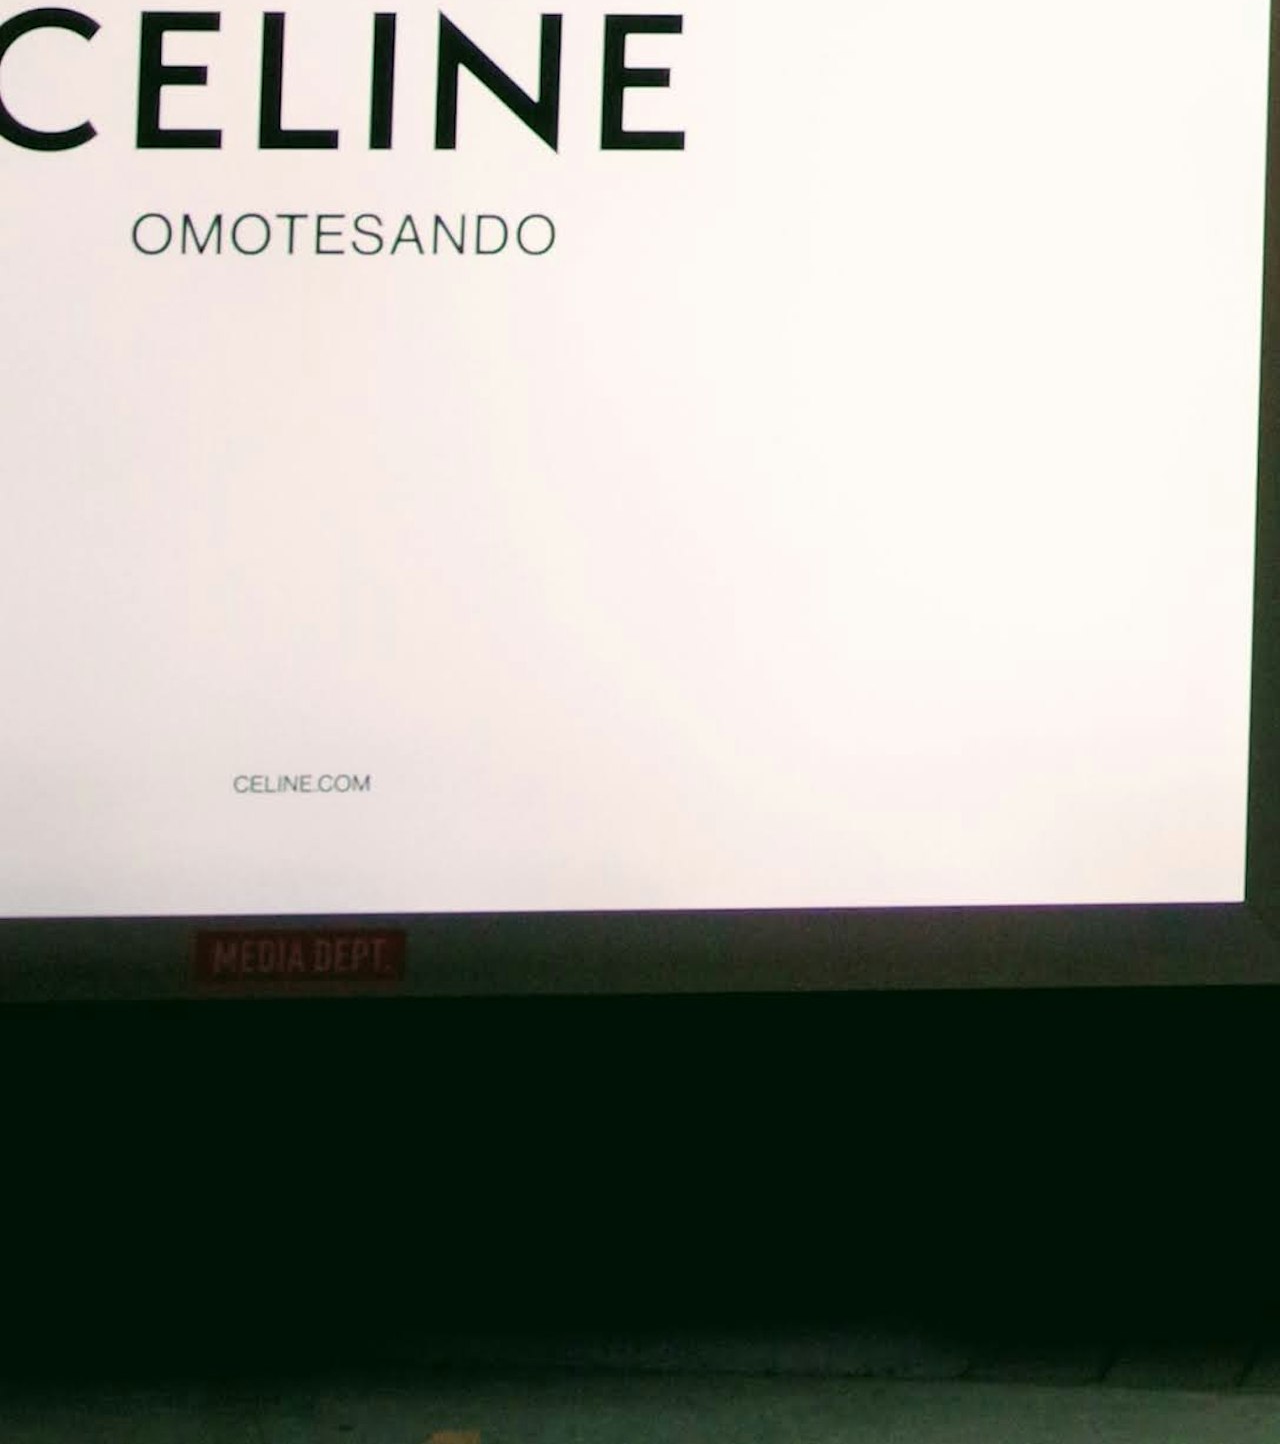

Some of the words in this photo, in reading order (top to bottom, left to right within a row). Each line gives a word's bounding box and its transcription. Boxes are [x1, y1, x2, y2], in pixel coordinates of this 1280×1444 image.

[0, 6, 686, 154] CELINE
[131, 212, 556, 256] OMOTESANDO
[232, 774, 372, 793] CELINE.COM
[213, 939, 305, 972] MEDIA
